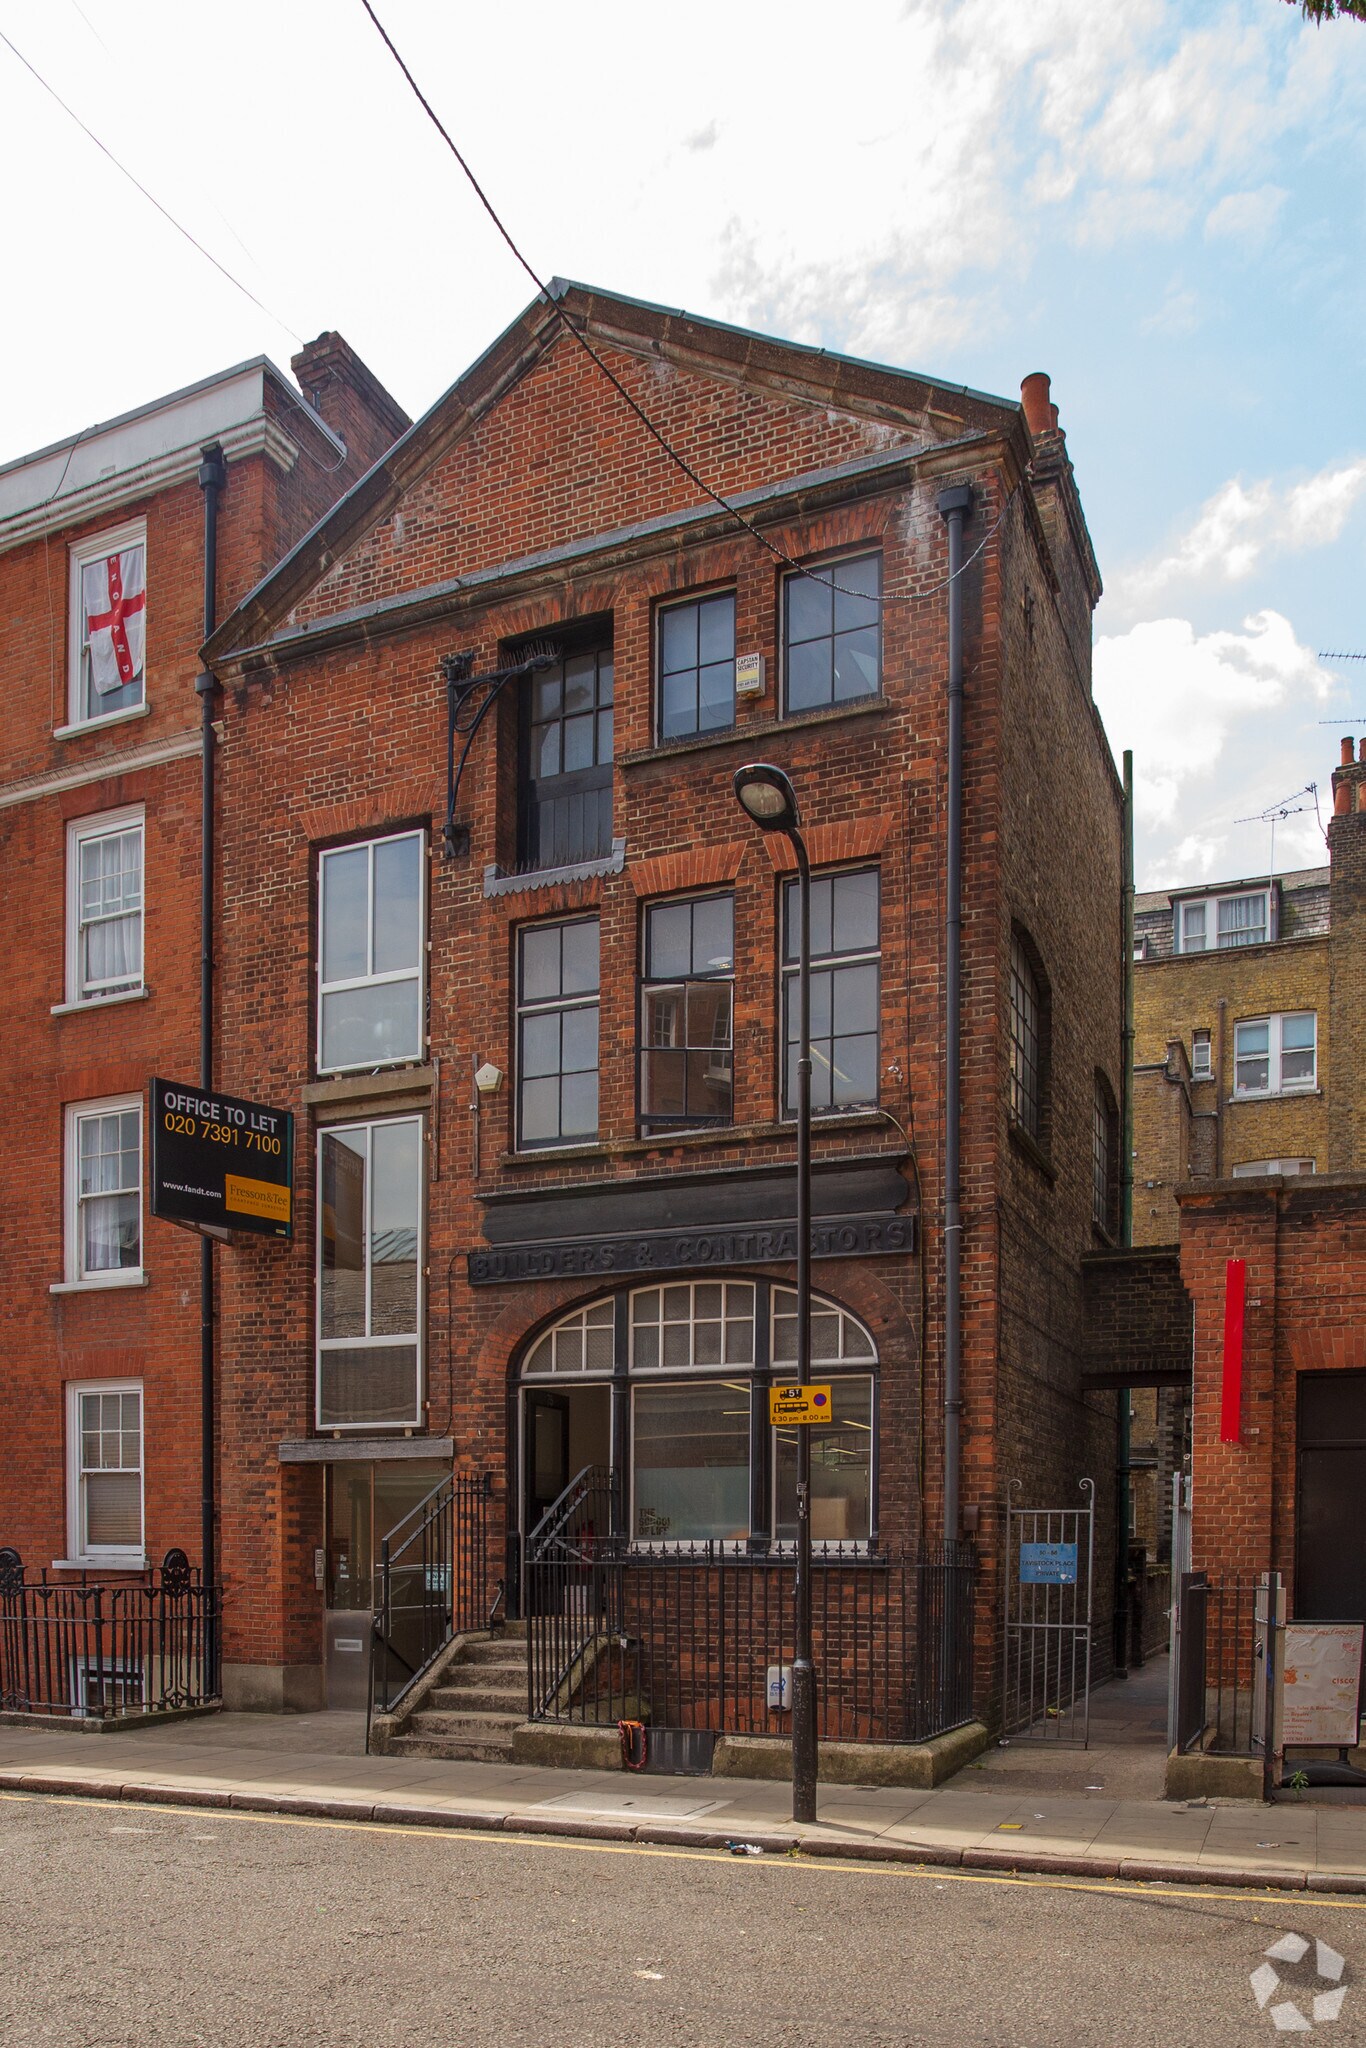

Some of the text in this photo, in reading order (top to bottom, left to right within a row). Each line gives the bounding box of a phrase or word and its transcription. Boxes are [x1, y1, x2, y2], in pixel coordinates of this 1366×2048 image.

[737, 656, 758, 666] CAPSTAN
[737, 662, 758, 671] SECURITY
[164, 1092, 277, 1134] OFFICE TO LET
[164, 1113, 281, 1155] 020 7391 7100
[162, 1181, 222, 1199] www.fandt.com
[230, 1184, 288, 1206] Fresson&Tee
[473, 1245, 614, 1280] BUILDERS
[635, 1243, 654, 1266] &
[639, 1508, 656, 1517] THE
[639, 1526, 650, 1536] OF
